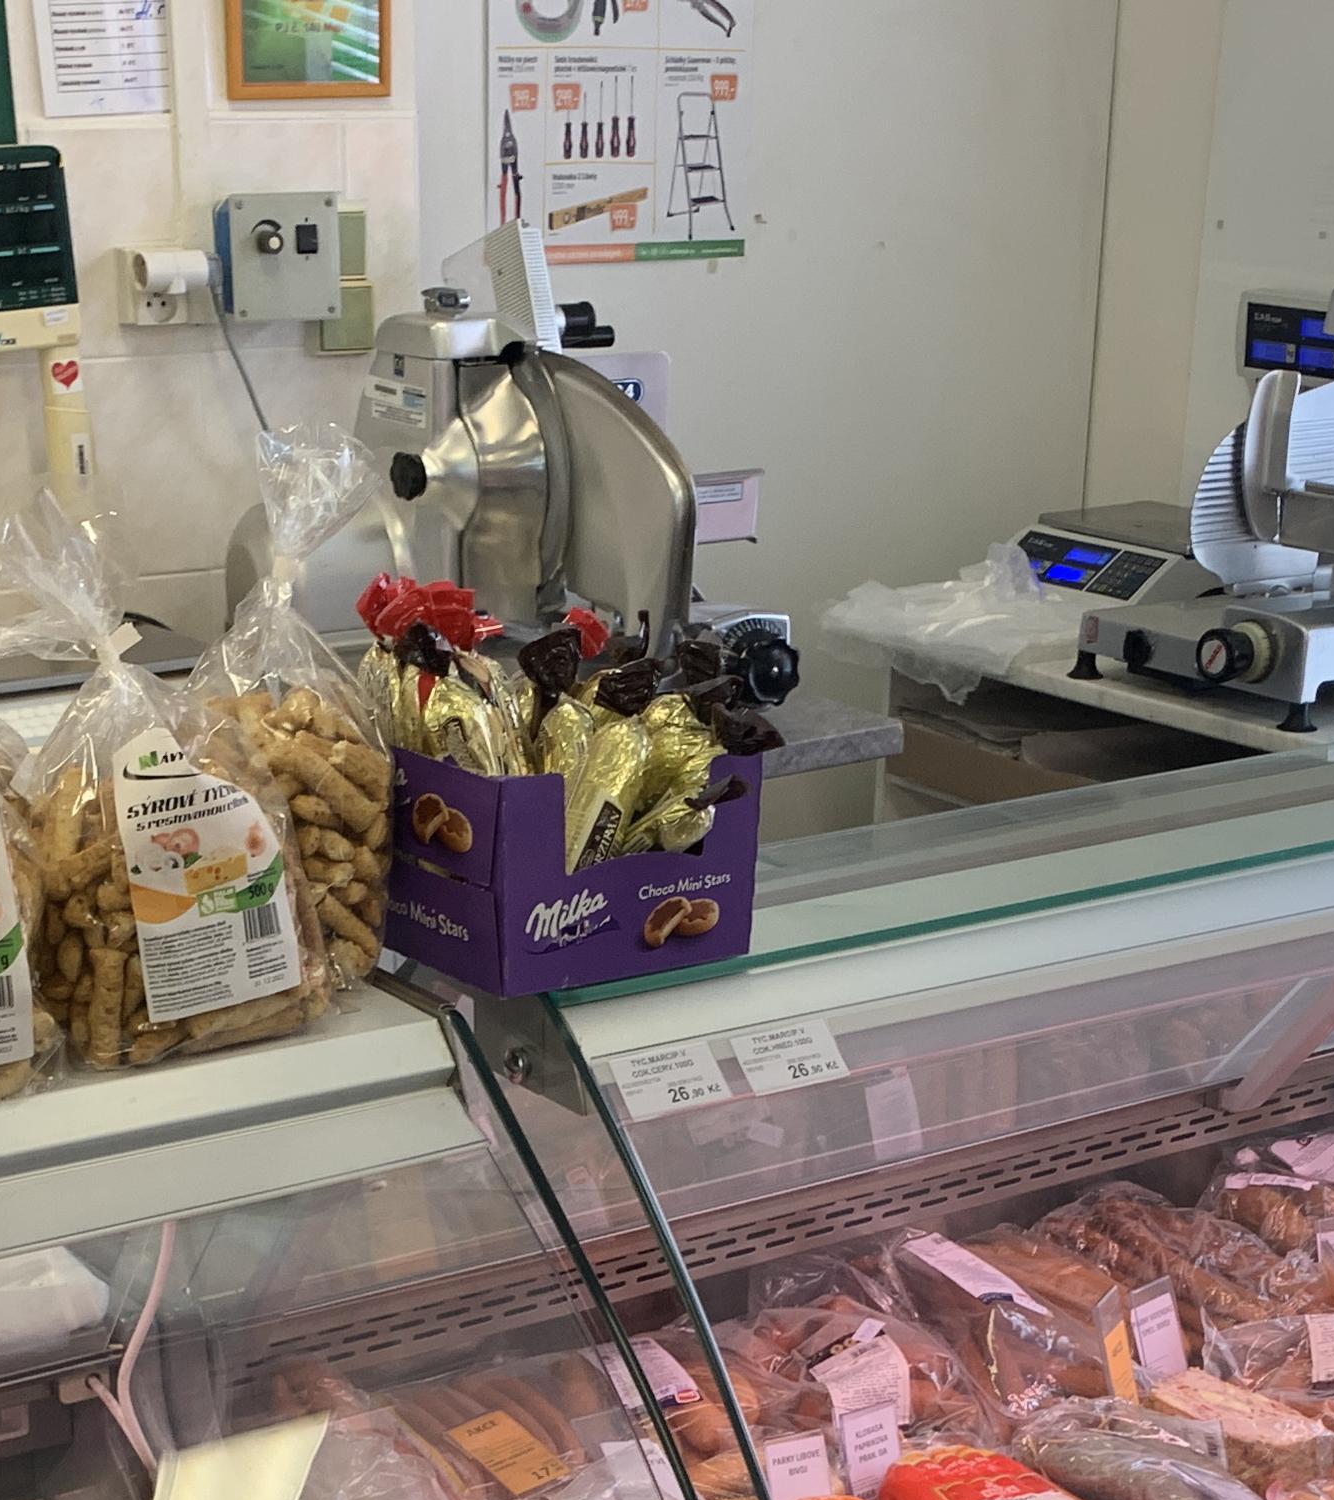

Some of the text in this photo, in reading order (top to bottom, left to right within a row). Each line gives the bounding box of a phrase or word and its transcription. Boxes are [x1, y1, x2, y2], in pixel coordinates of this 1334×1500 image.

[638, 871, 731, 901] Choco Mini Stars
[410, 903, 470, 942] Mini Stars
[524, 888, 609, 943] Milka
